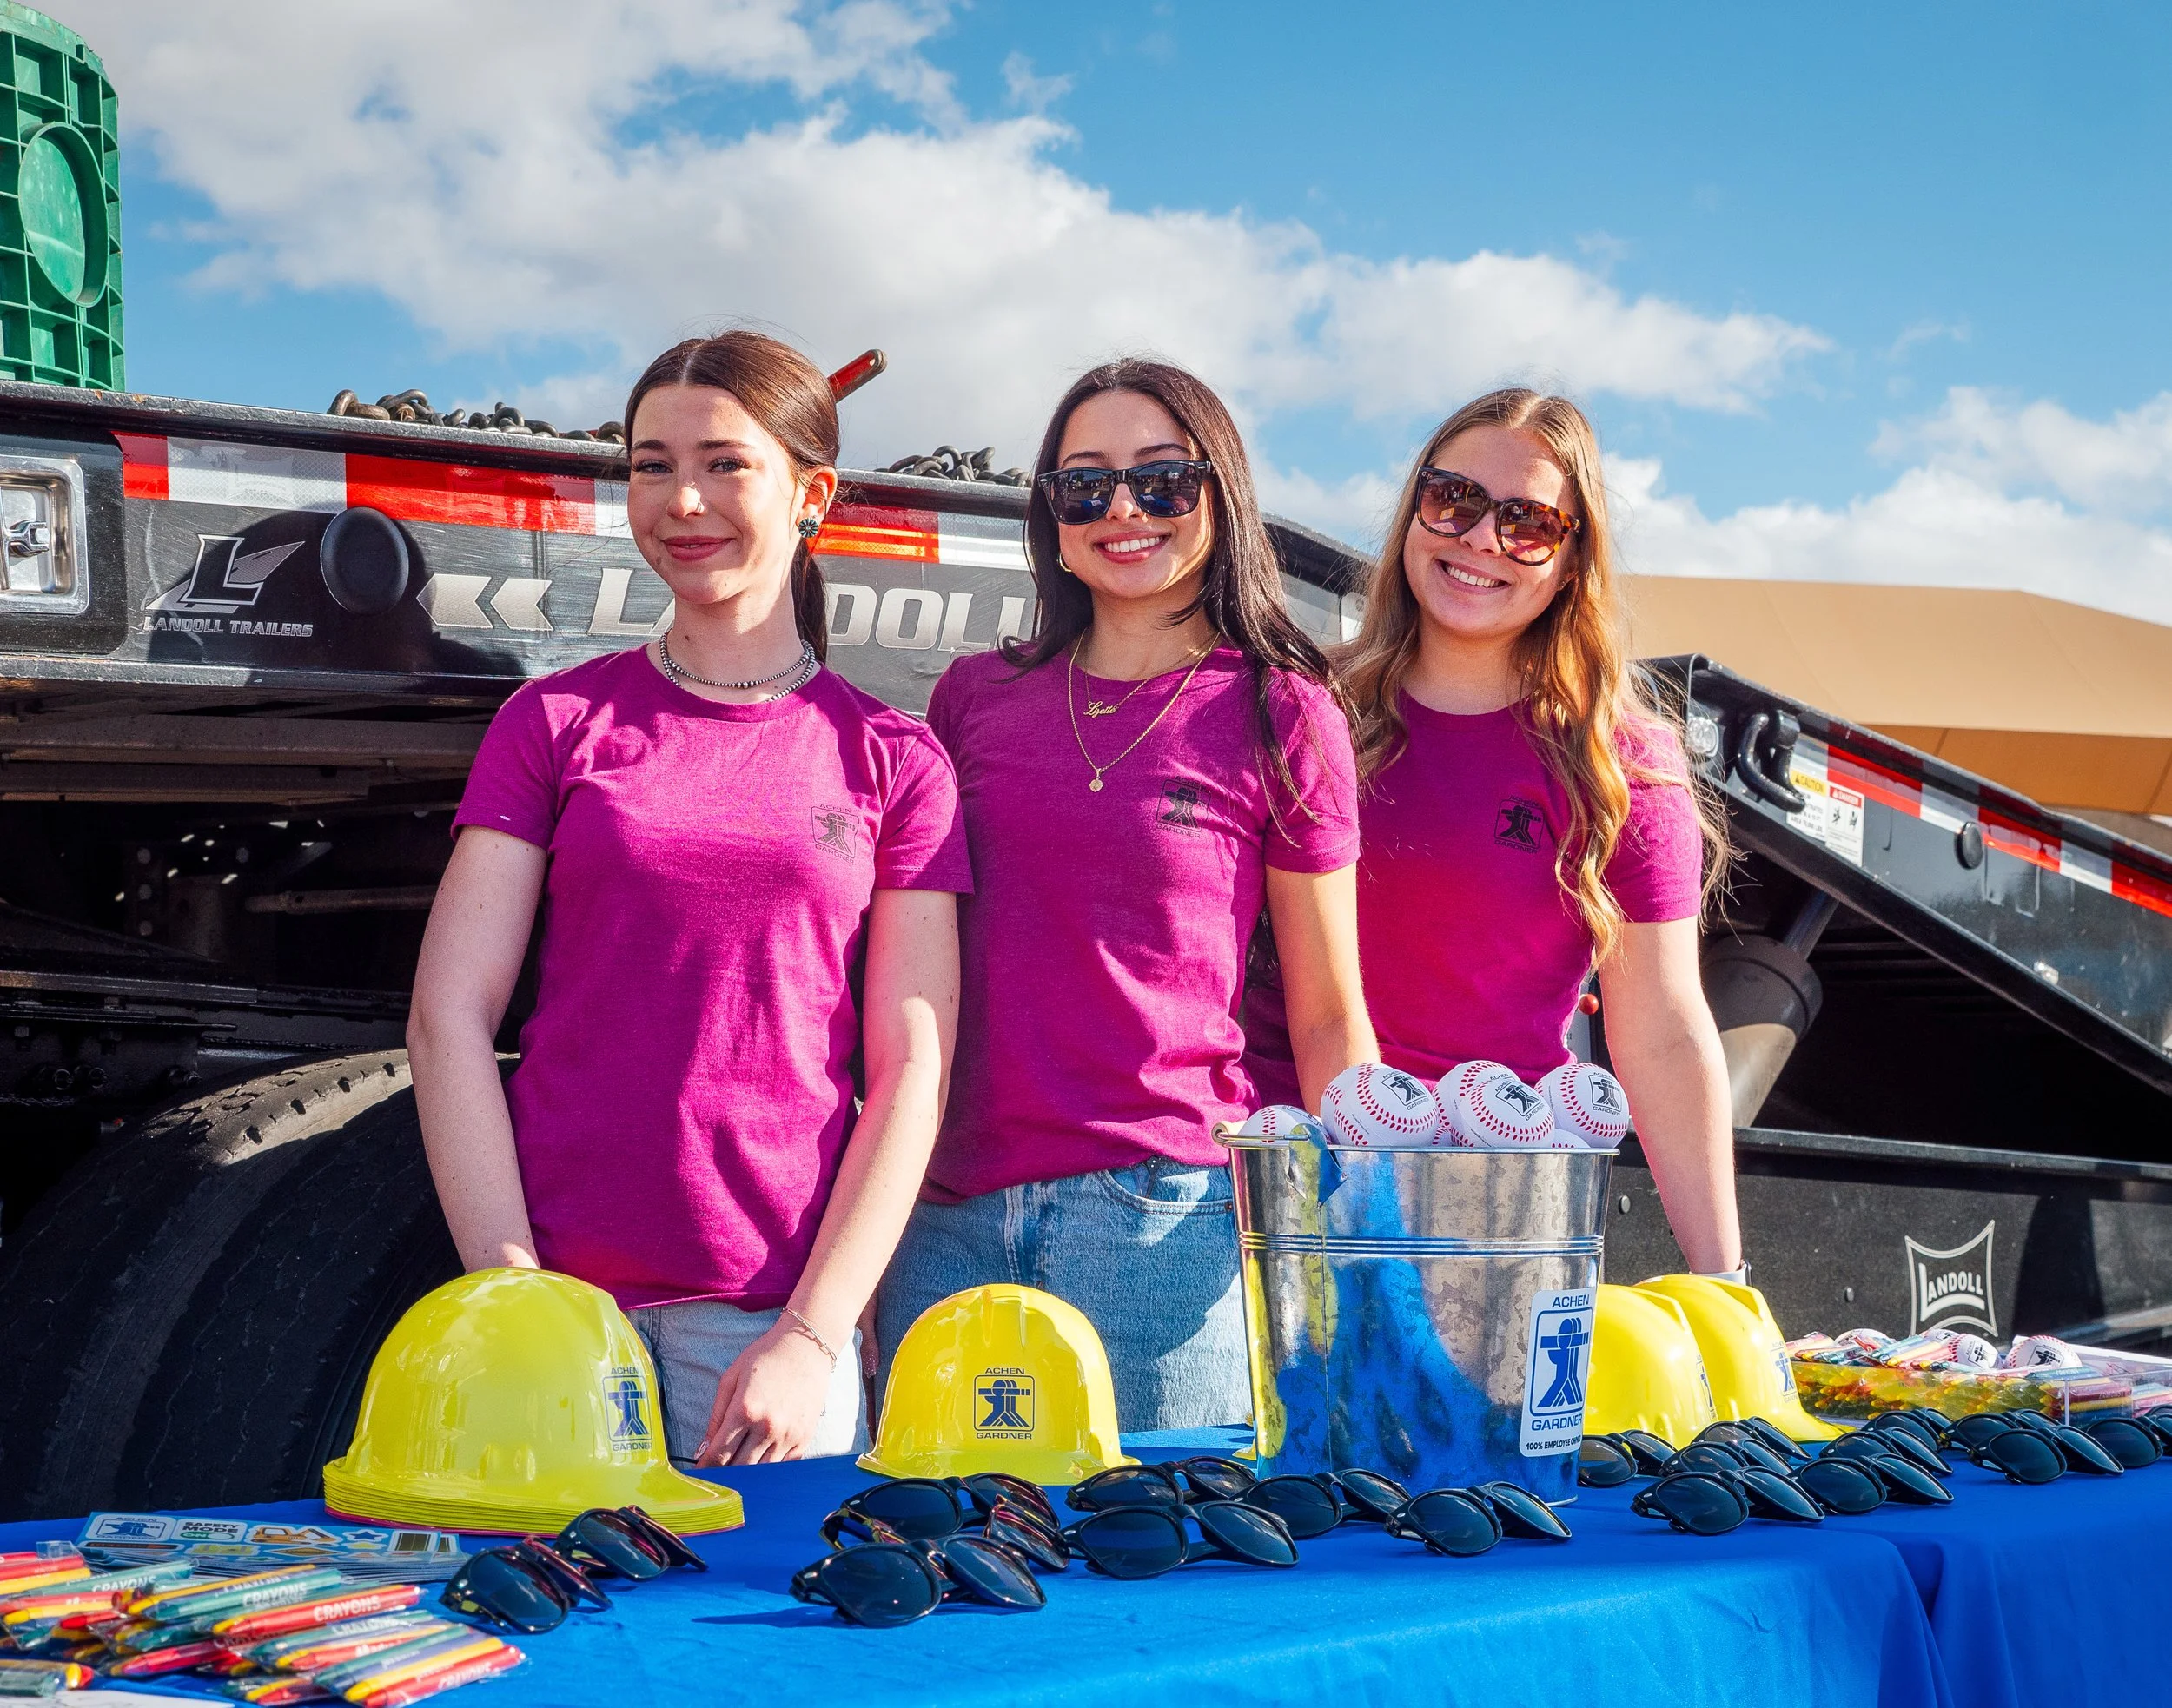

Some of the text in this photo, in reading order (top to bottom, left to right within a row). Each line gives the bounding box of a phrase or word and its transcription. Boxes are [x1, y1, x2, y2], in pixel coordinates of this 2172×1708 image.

[143, 616, 314, 638] LANDOLL TRAILERS
[1156, 824, 1201, 838] GARDNER
[815, 844, 855, 864] GARDNER
[1592, 1105, 1621, 1118] GARDNER
[1918, 1261, 1986, 1322] LANDOLL
[1551, 1294, 1590, 1308] ACHEN
[1531, 1413, 1583, 1432] GARDNER
[976, 1432, 1032, 1440] GARDNER
[612, 1442, 653, 1452] GARDNER
[1526, 1441, 1543, 1451] 100%
[1544, 1438, 1571, 1449] EMPLOYEE
[242, 1583, 308, 1607] CRAYONS
[313, 1594, 381, 1622] CRAYONS
